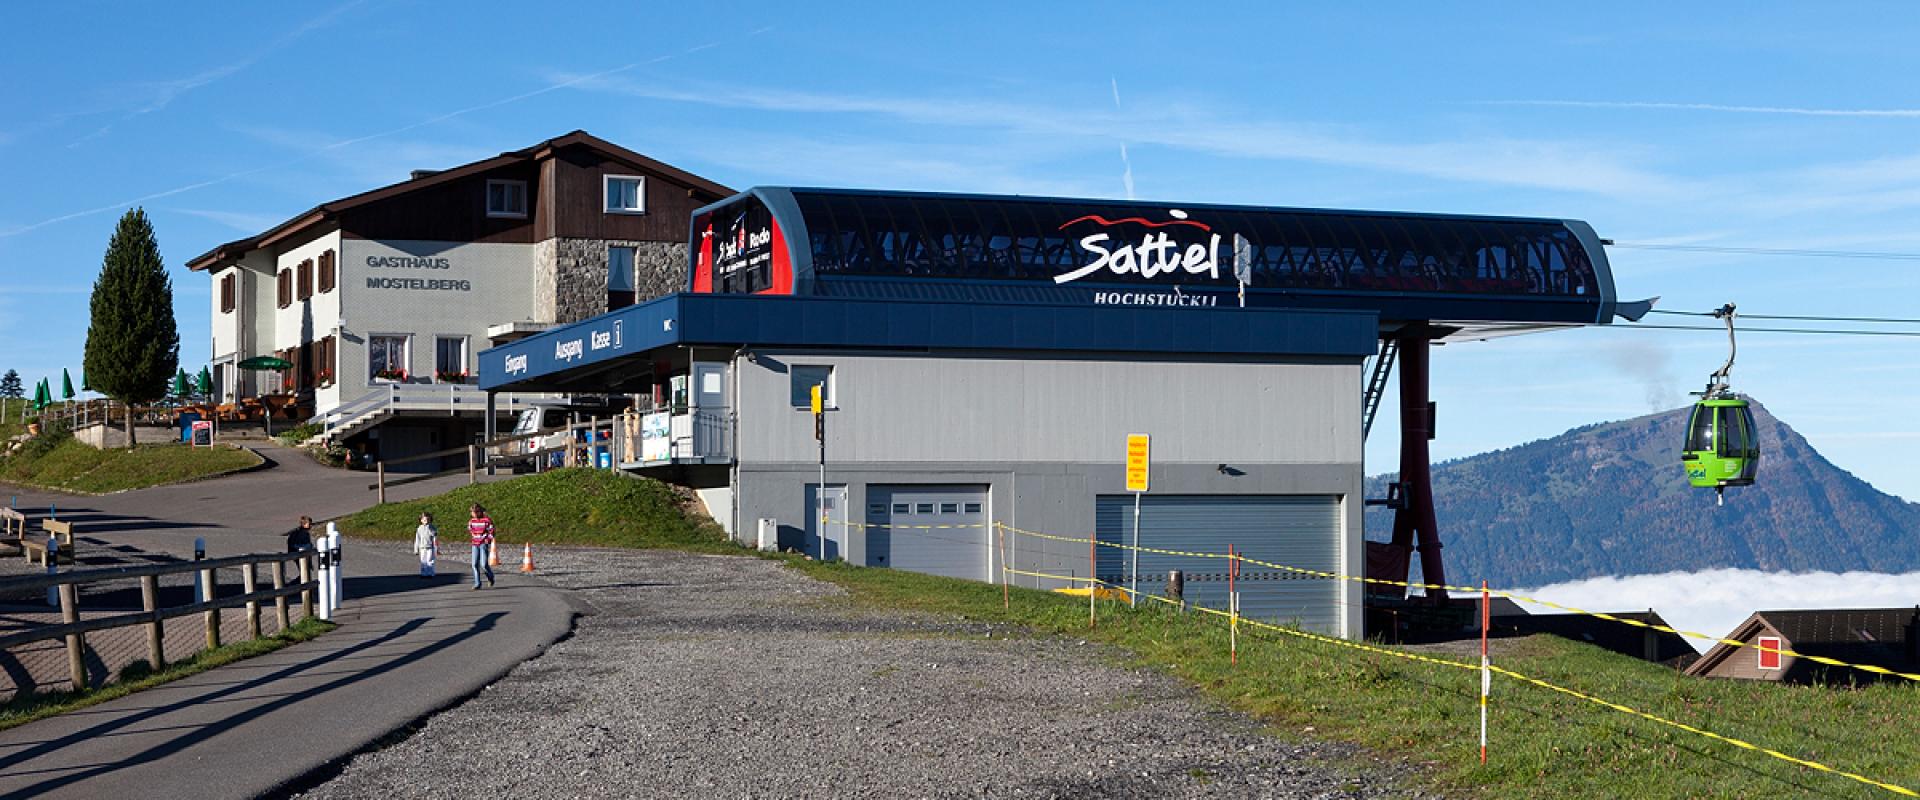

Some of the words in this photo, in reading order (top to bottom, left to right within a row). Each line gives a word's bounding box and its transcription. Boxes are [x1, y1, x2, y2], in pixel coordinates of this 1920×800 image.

[365, 255, 450, 270] GASTHAUS
[1053, 232, 1221, 284] Sattel
[365, 277, 471, 291] MOSTELBERG
[504, 354, 527, 376] Eingang
[555, 338, 583, 362] Ausgang
[591, 331, 611, 350] Kasse
